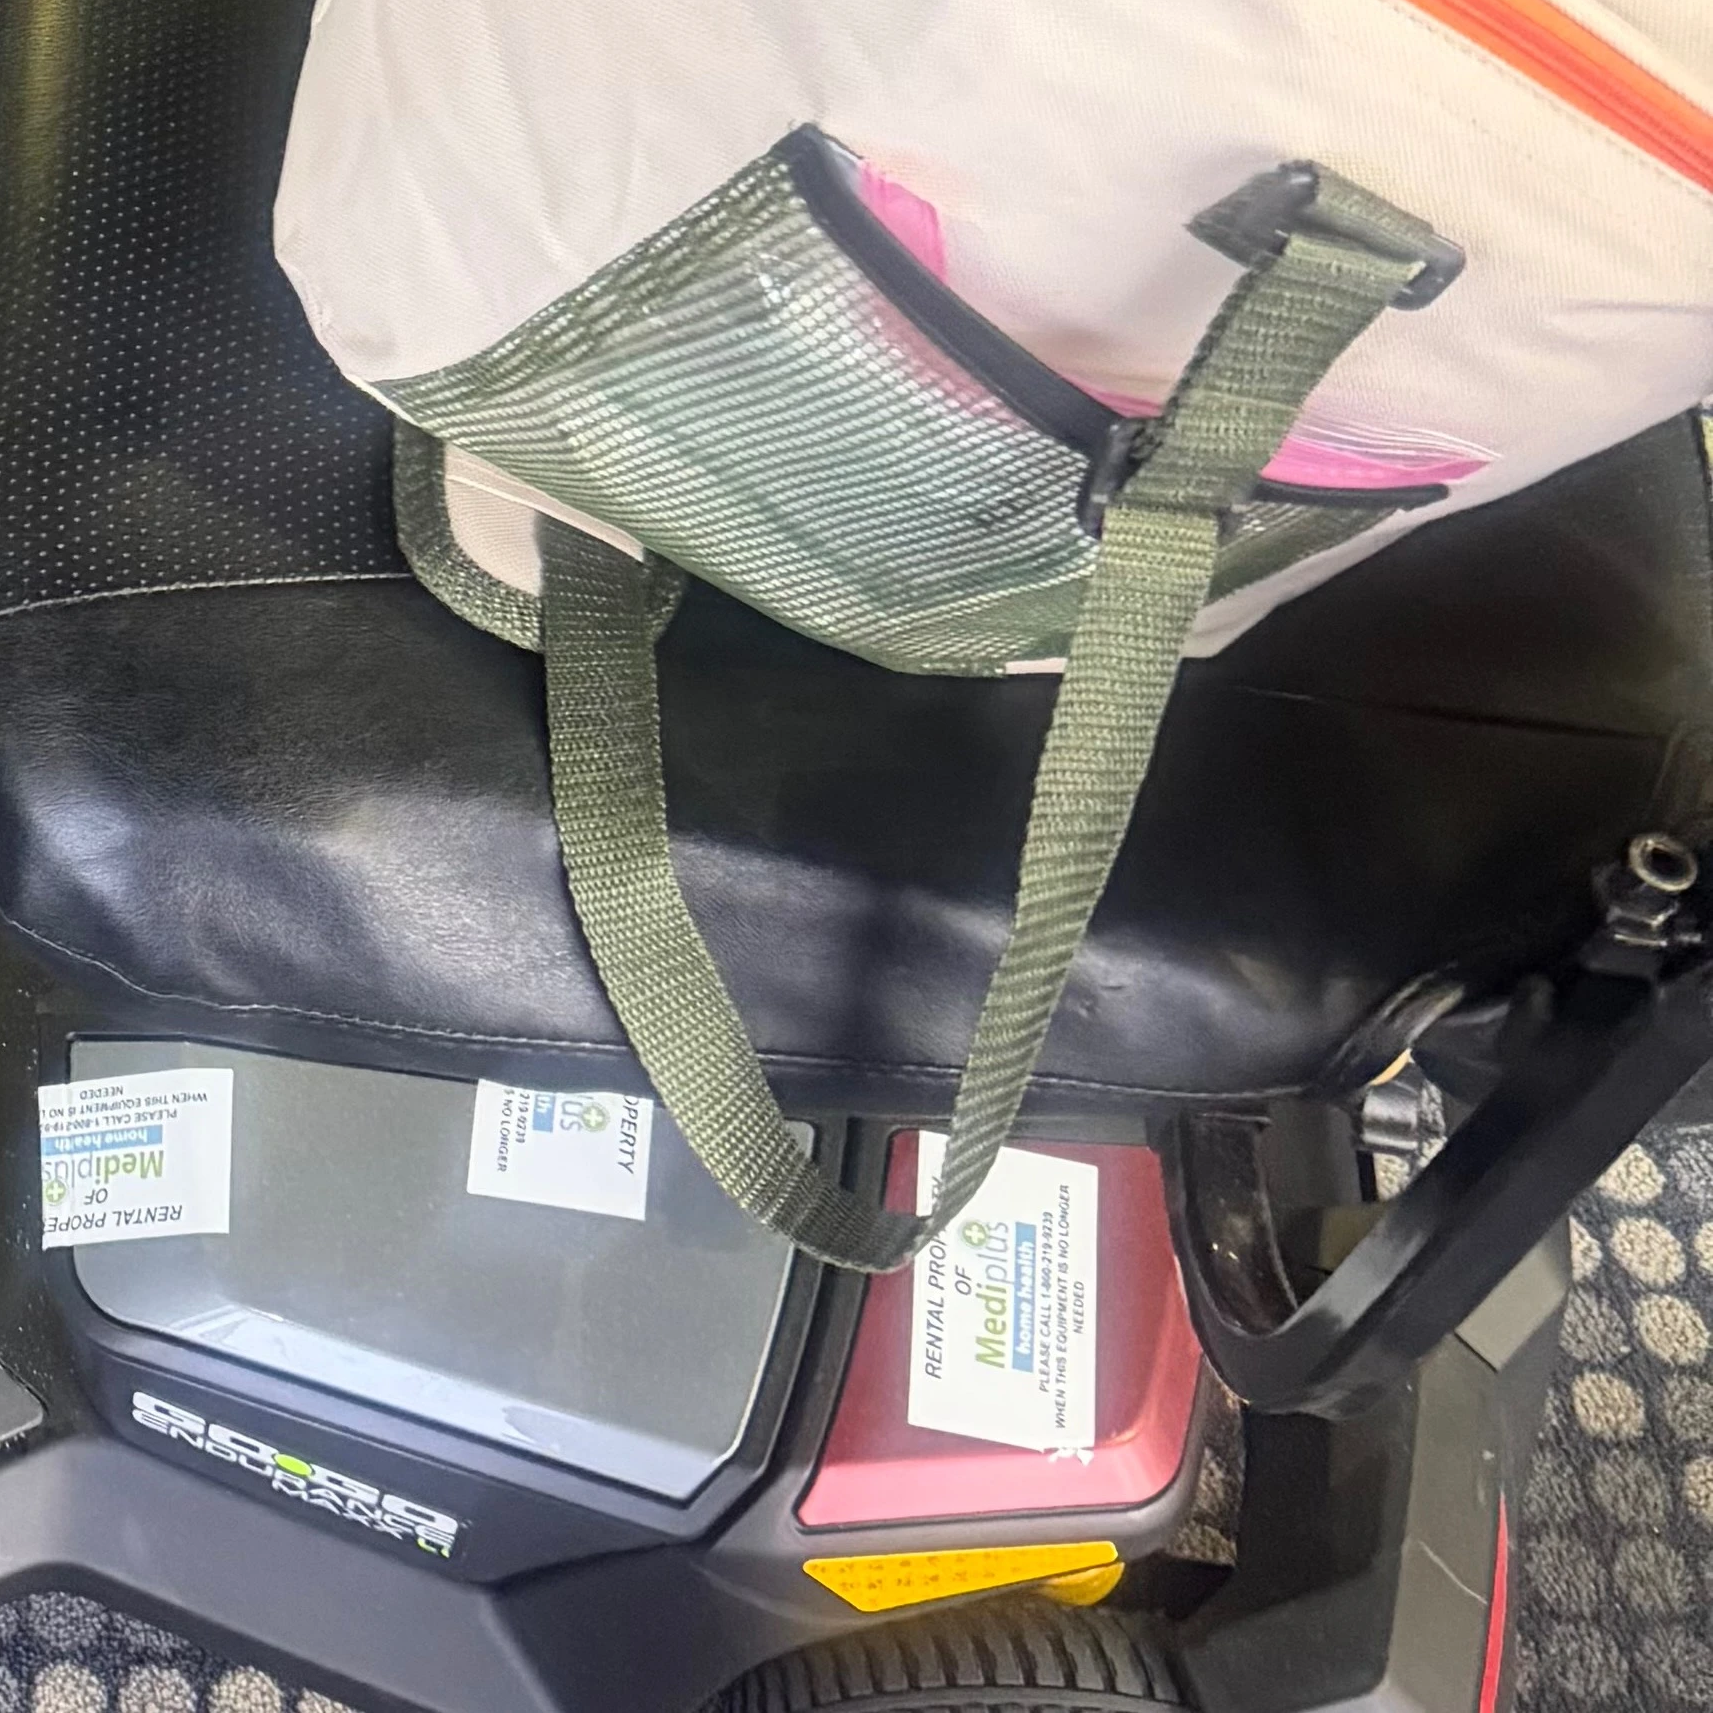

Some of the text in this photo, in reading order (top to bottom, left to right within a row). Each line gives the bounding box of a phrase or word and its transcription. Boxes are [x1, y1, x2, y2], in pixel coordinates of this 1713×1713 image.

[80, 1086, 124, 1101] NEEDED
[80, 1097, 141, 1115] EQUIPMENT
[145, 1095, 169, 1105] THIS
[172, 1092, 208, 1104] WHEN
[502, 1099, 513, 1117] NO
[49, 1108, 64, 1119] NO
[103, 1114, 131, 1126] CALL
[135, 1109, 177, 1123] PLEASE
[55, 1128, 147, 1151] home health
[497, 1120, 512, 1172] LONGER
[84, 1188, 108, 1205] OF
[1059, 1184, 1070, 1236] LONGER
[43, 1205, 183, 1232] RENTAL PROPE
[1058, 1240, 1069, 1257] NO
[955, 1265, 972, 1296] OF
[975, 1221, 1014, 1369] Mediplus
[1015, 1240, 1035, 1355] home health
[1073, 1281, 1085, 1335] NEEDED
[1040, 1303, 1052, 1339] CALL
[1056, 1276, 1069, 1352] EQUIPMENT
[925, 1296, 945, 1380] RENTAL
[1039, 1341, 1051, 1393] PLEASE
[1056, 1356, 1067, 1385] THIS
[1055, 1389, 1066, 1429] WHEN
[131, 1408, 455, 1550] ENDURANCE
